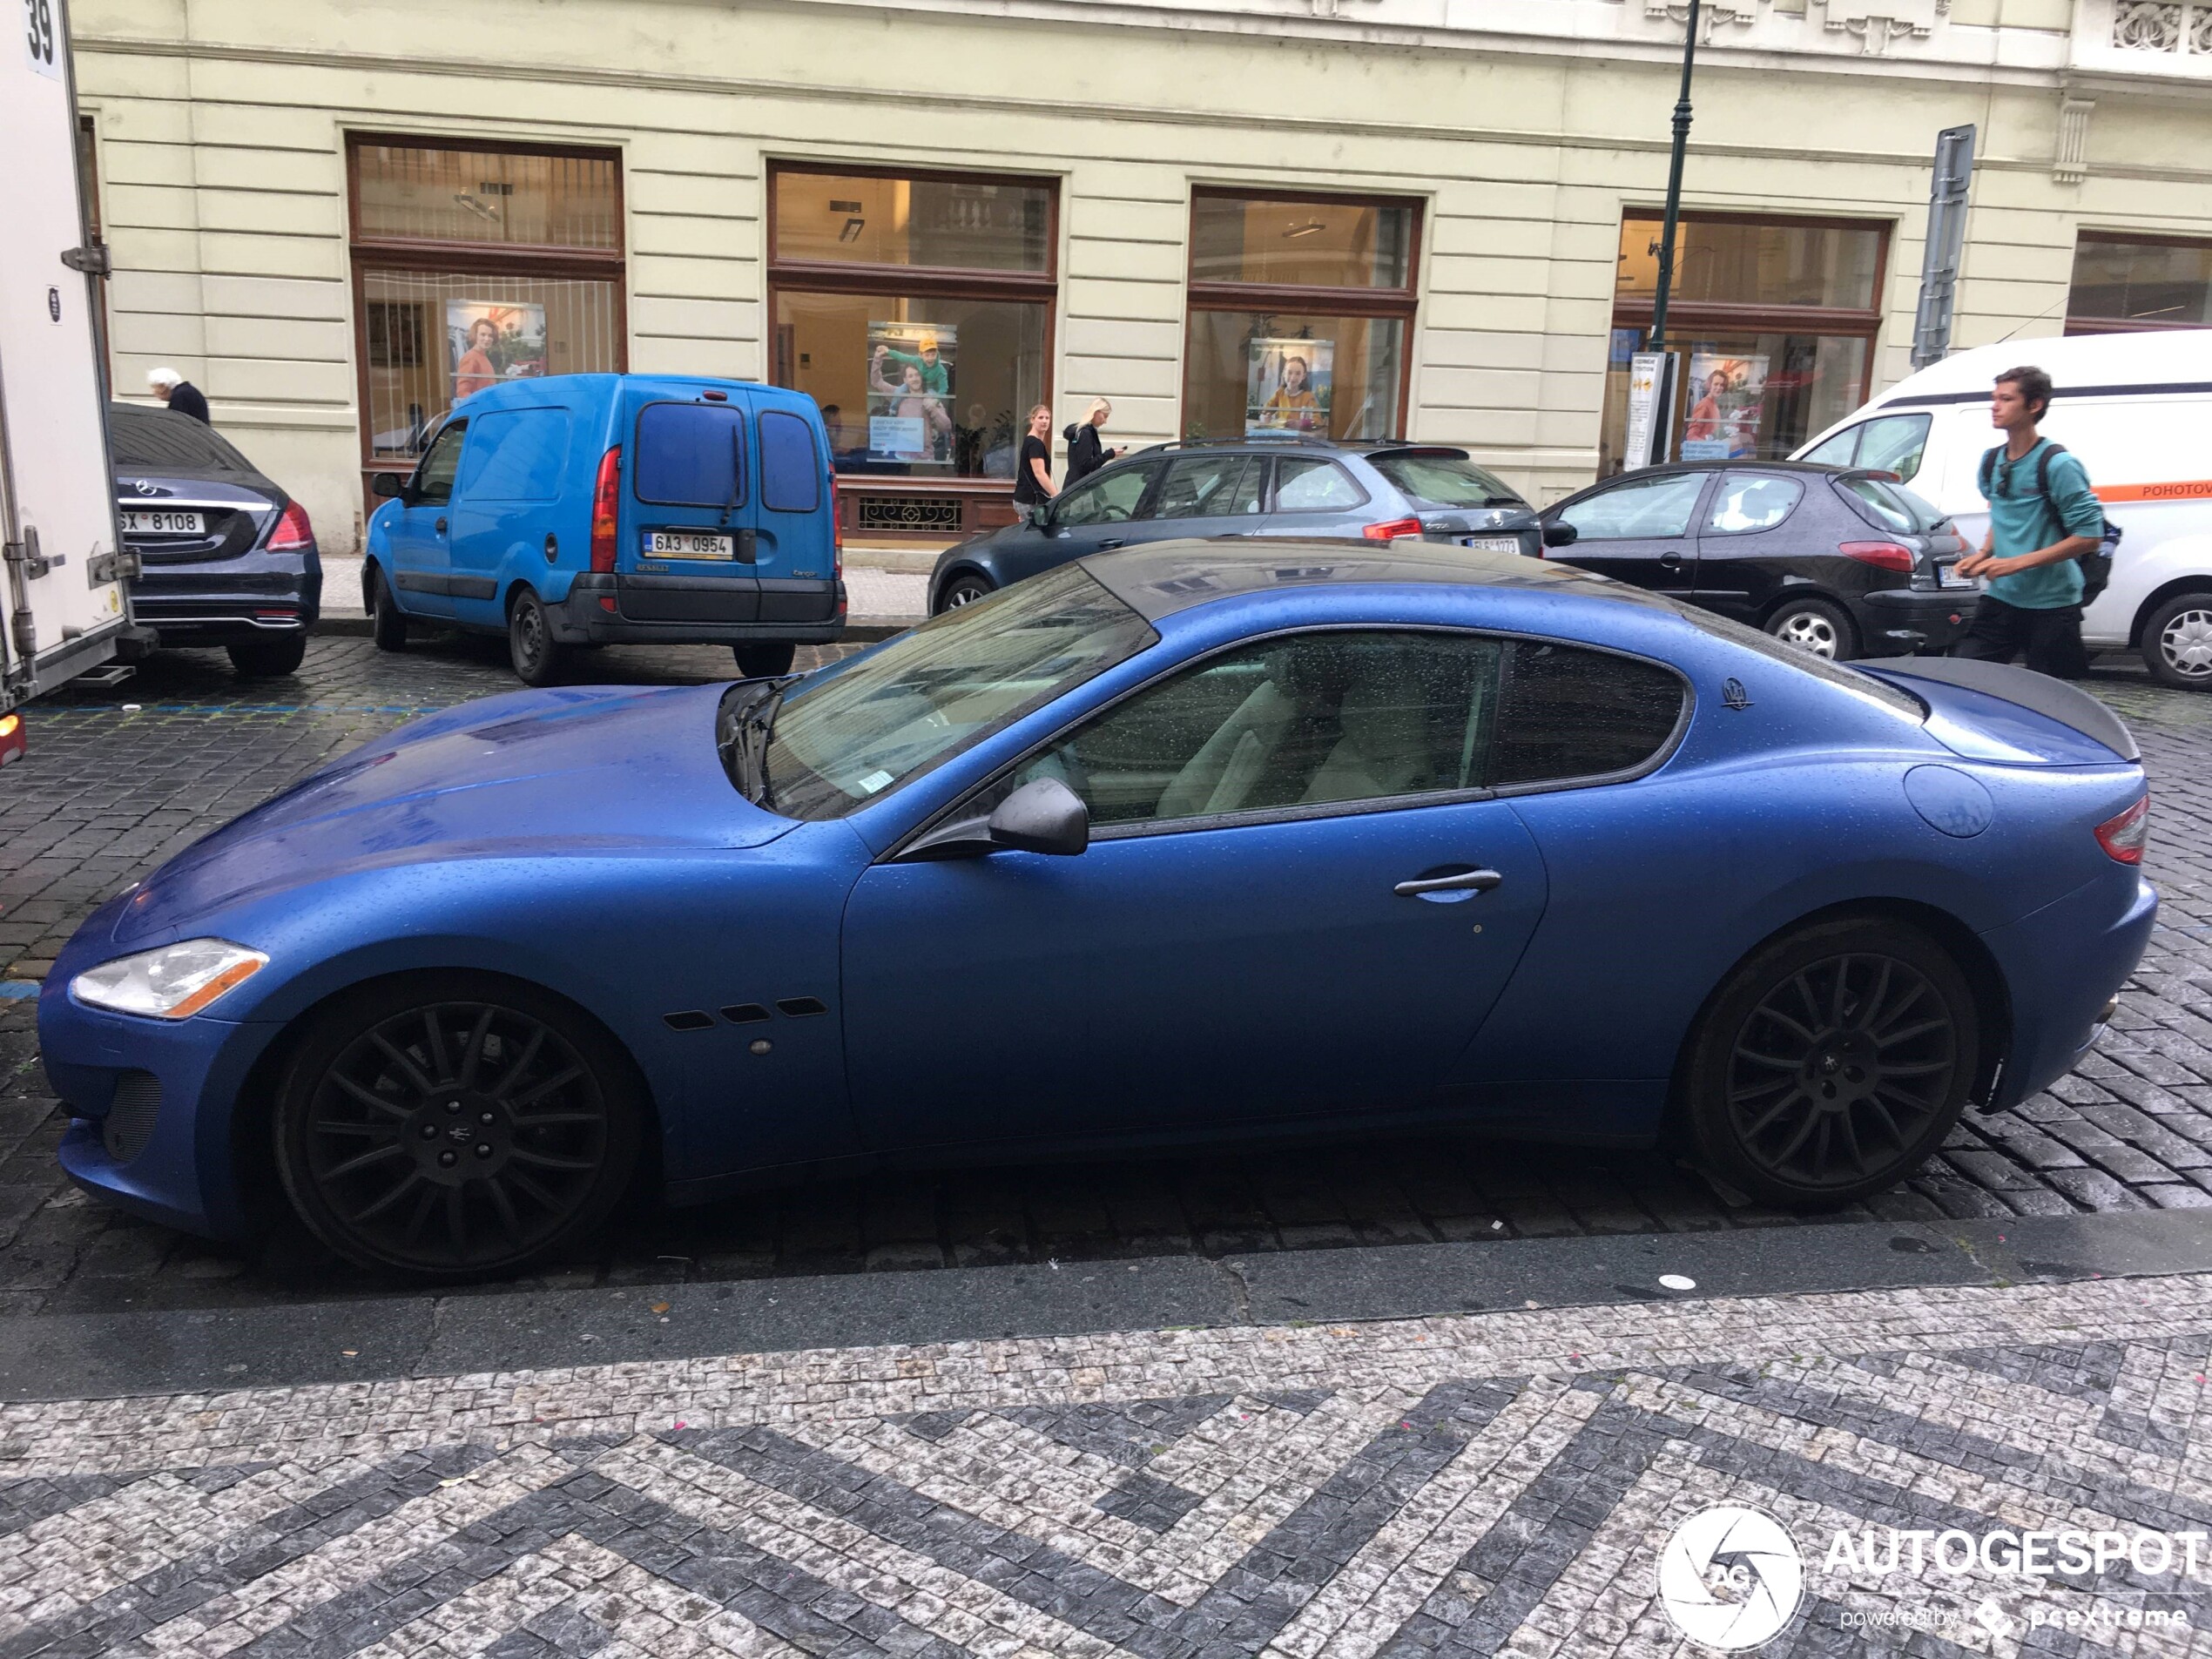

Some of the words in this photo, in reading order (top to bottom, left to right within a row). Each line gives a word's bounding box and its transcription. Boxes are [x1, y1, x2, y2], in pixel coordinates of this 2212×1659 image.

[25, 0, 53, 65] 39
[152, 514, 196, 530] 8108
[655, 535, 682, 550] 6A3
[691, 536, 726, 553] 0954
